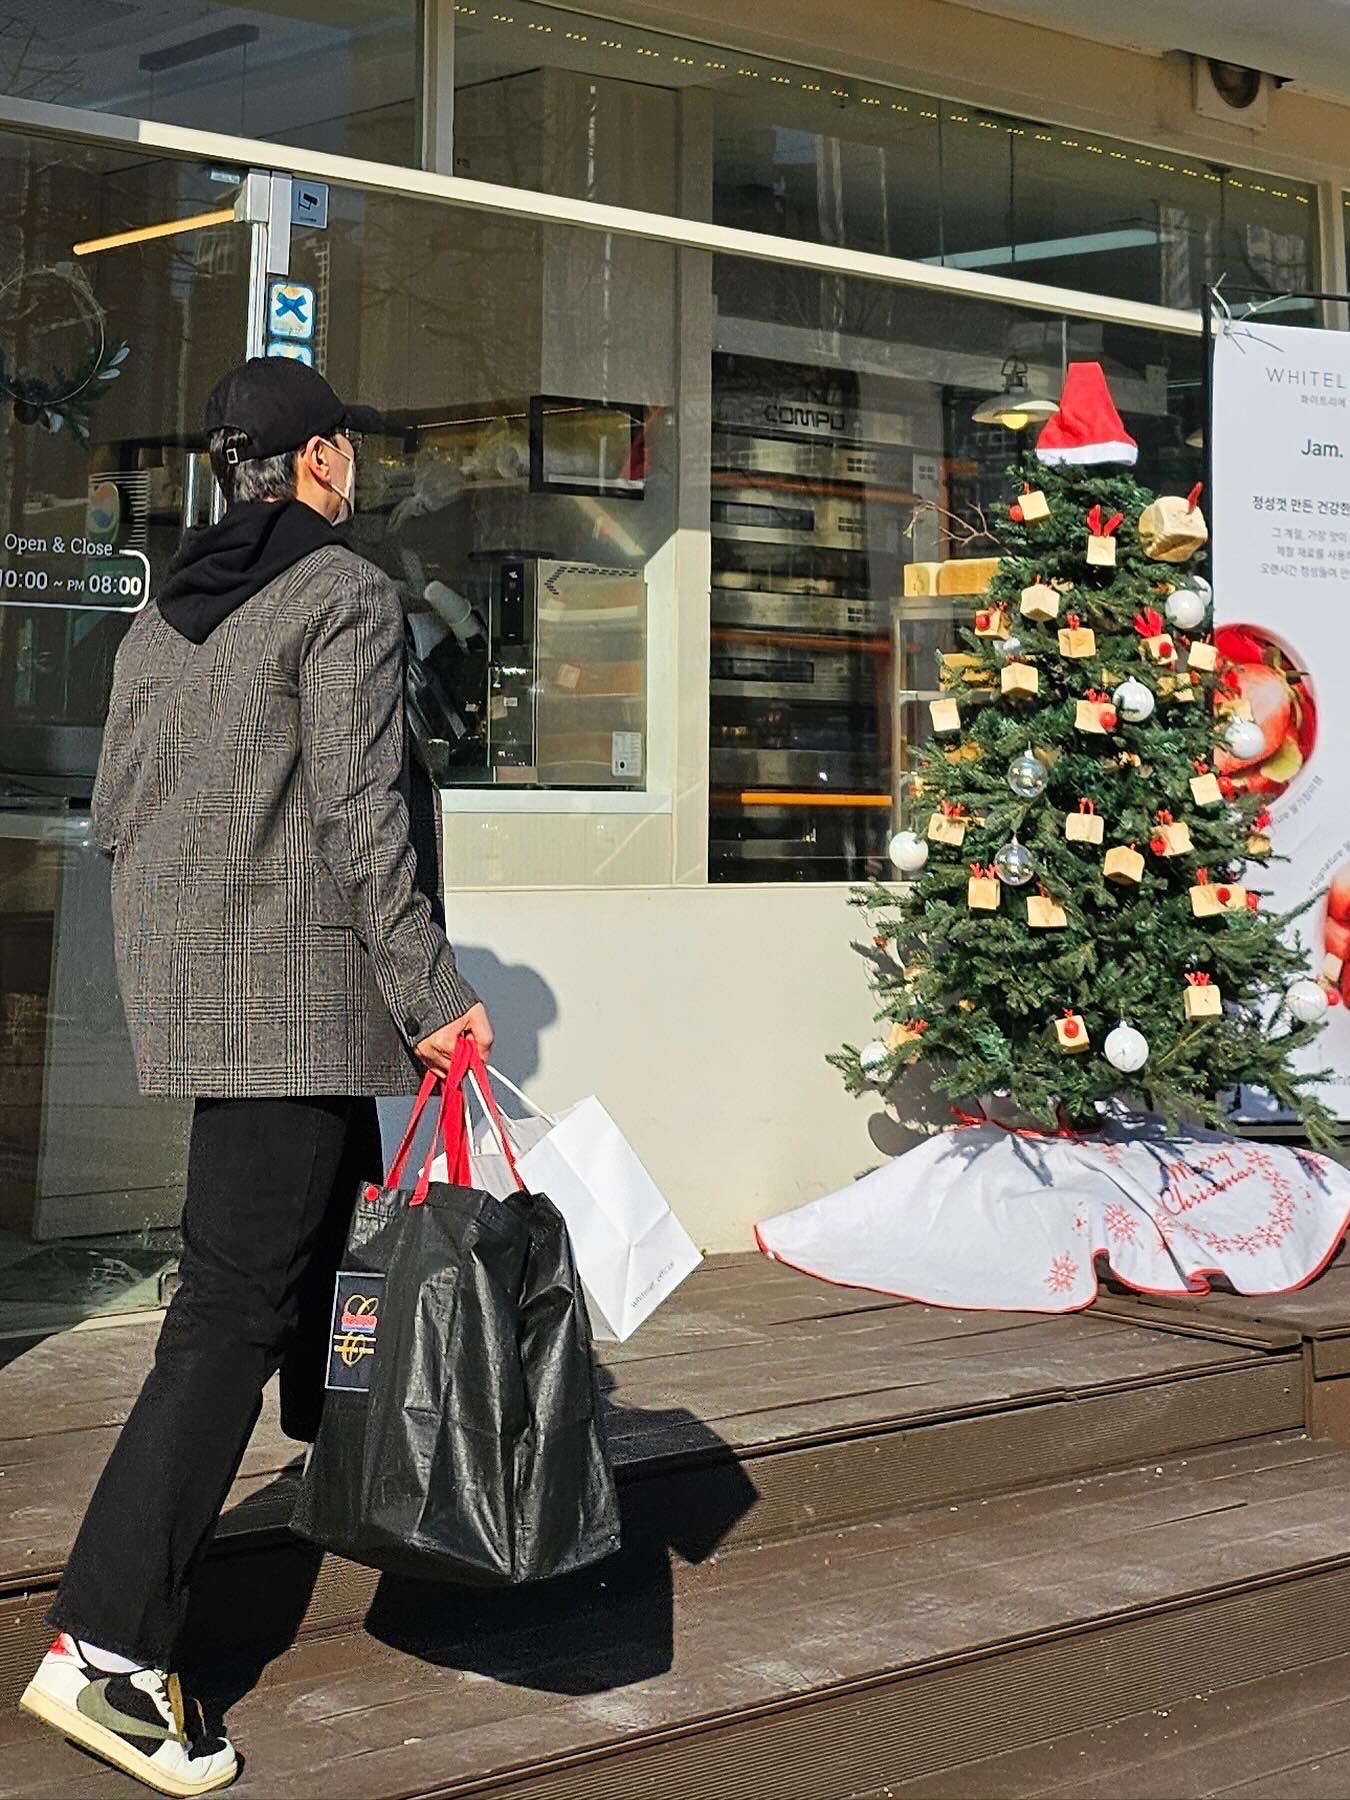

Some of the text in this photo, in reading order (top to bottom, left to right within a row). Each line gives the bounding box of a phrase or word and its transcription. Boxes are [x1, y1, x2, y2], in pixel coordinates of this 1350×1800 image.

[1301, 439, 1344, 458] Jam.
[1252, 495, 1287, 512] 정성껏
[1291, 498, 1313, 514] 만든
[5, 533, 113, 556] Open & Close
[67, 579, 85, 592] PM
[89, 575, 142, 596] 08:00
